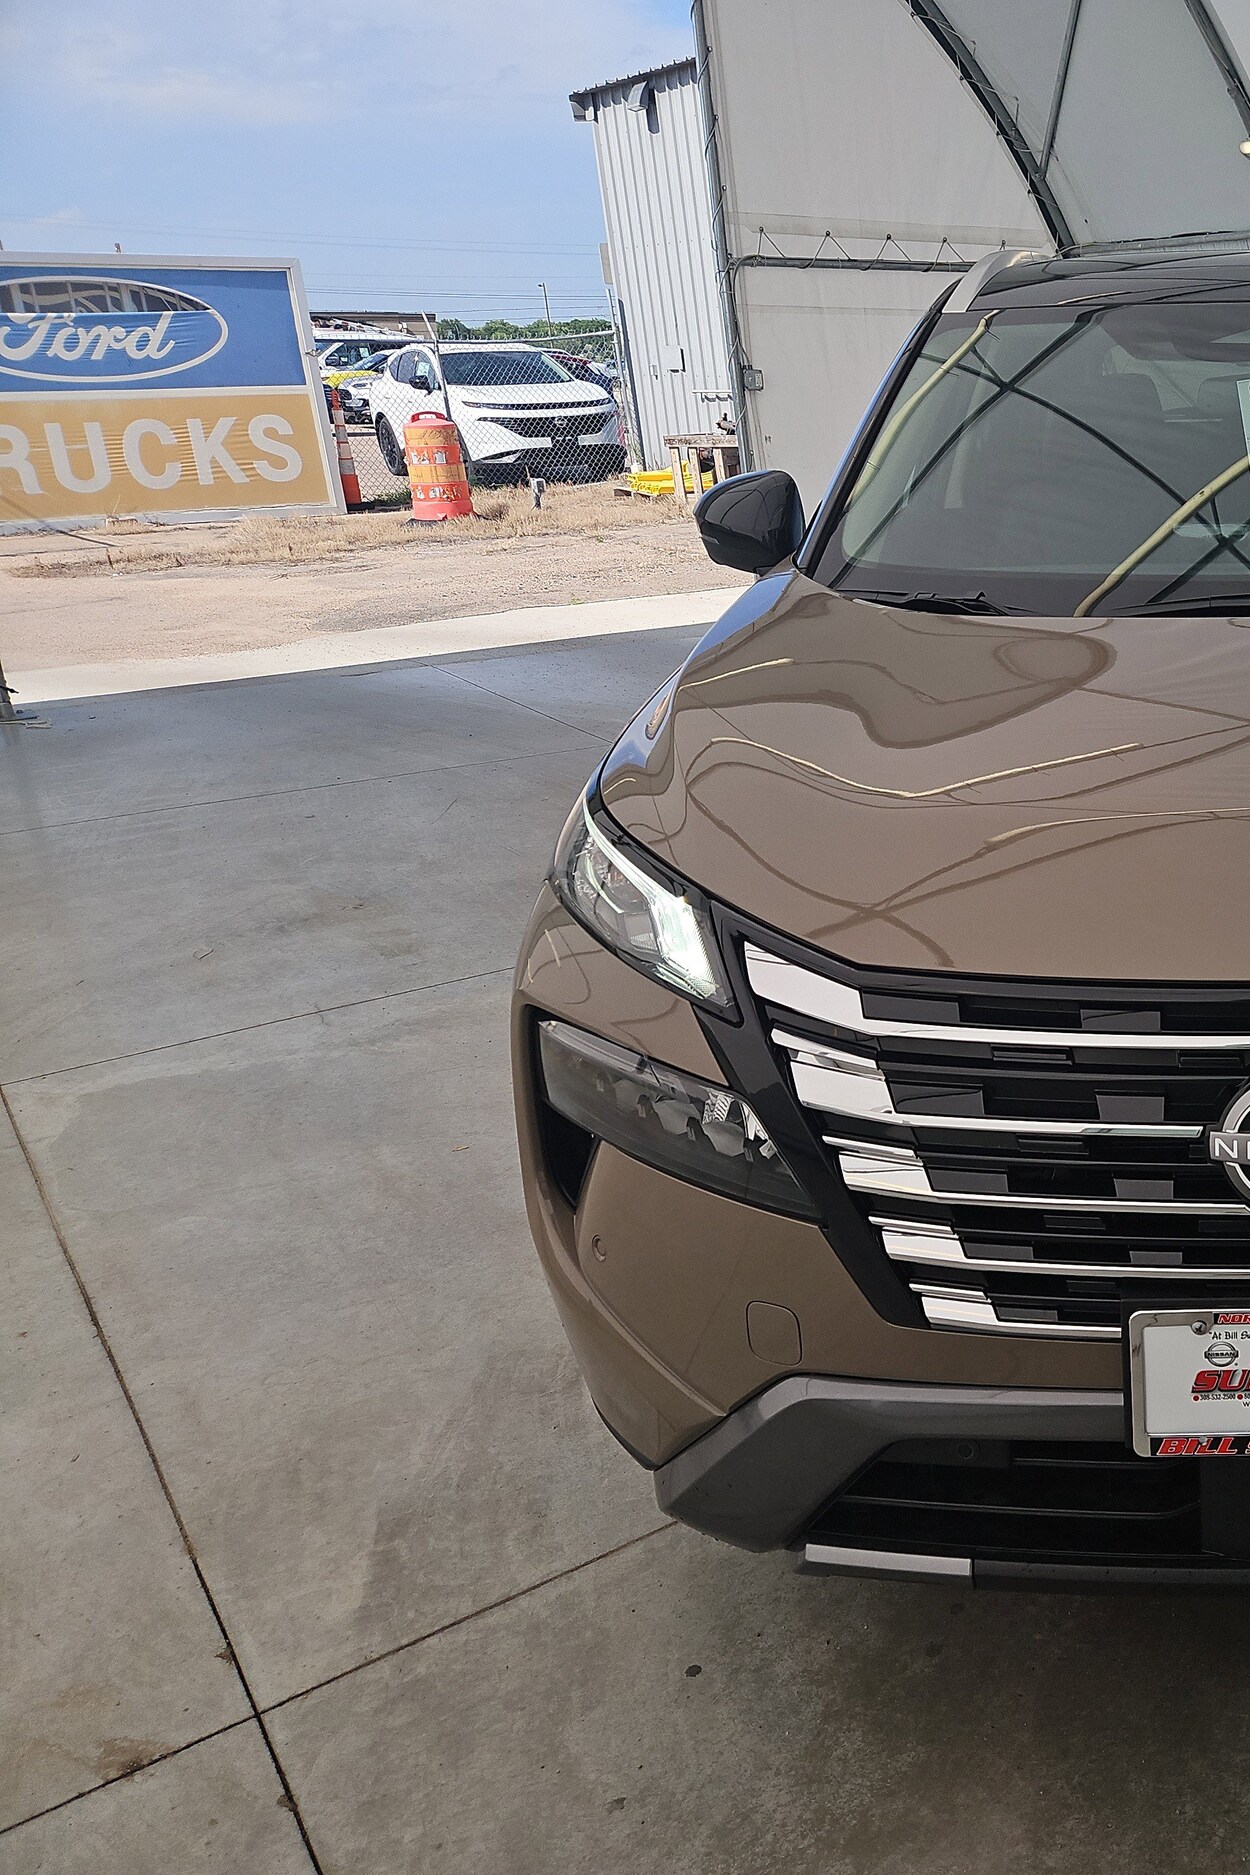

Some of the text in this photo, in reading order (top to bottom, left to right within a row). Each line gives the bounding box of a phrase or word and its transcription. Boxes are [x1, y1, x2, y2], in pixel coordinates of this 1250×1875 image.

[0, 312, 175, 361] Ford
[1224, 1331, 1238, 1340] Bill
[1157, 1437, 1238, 1456] BILL
